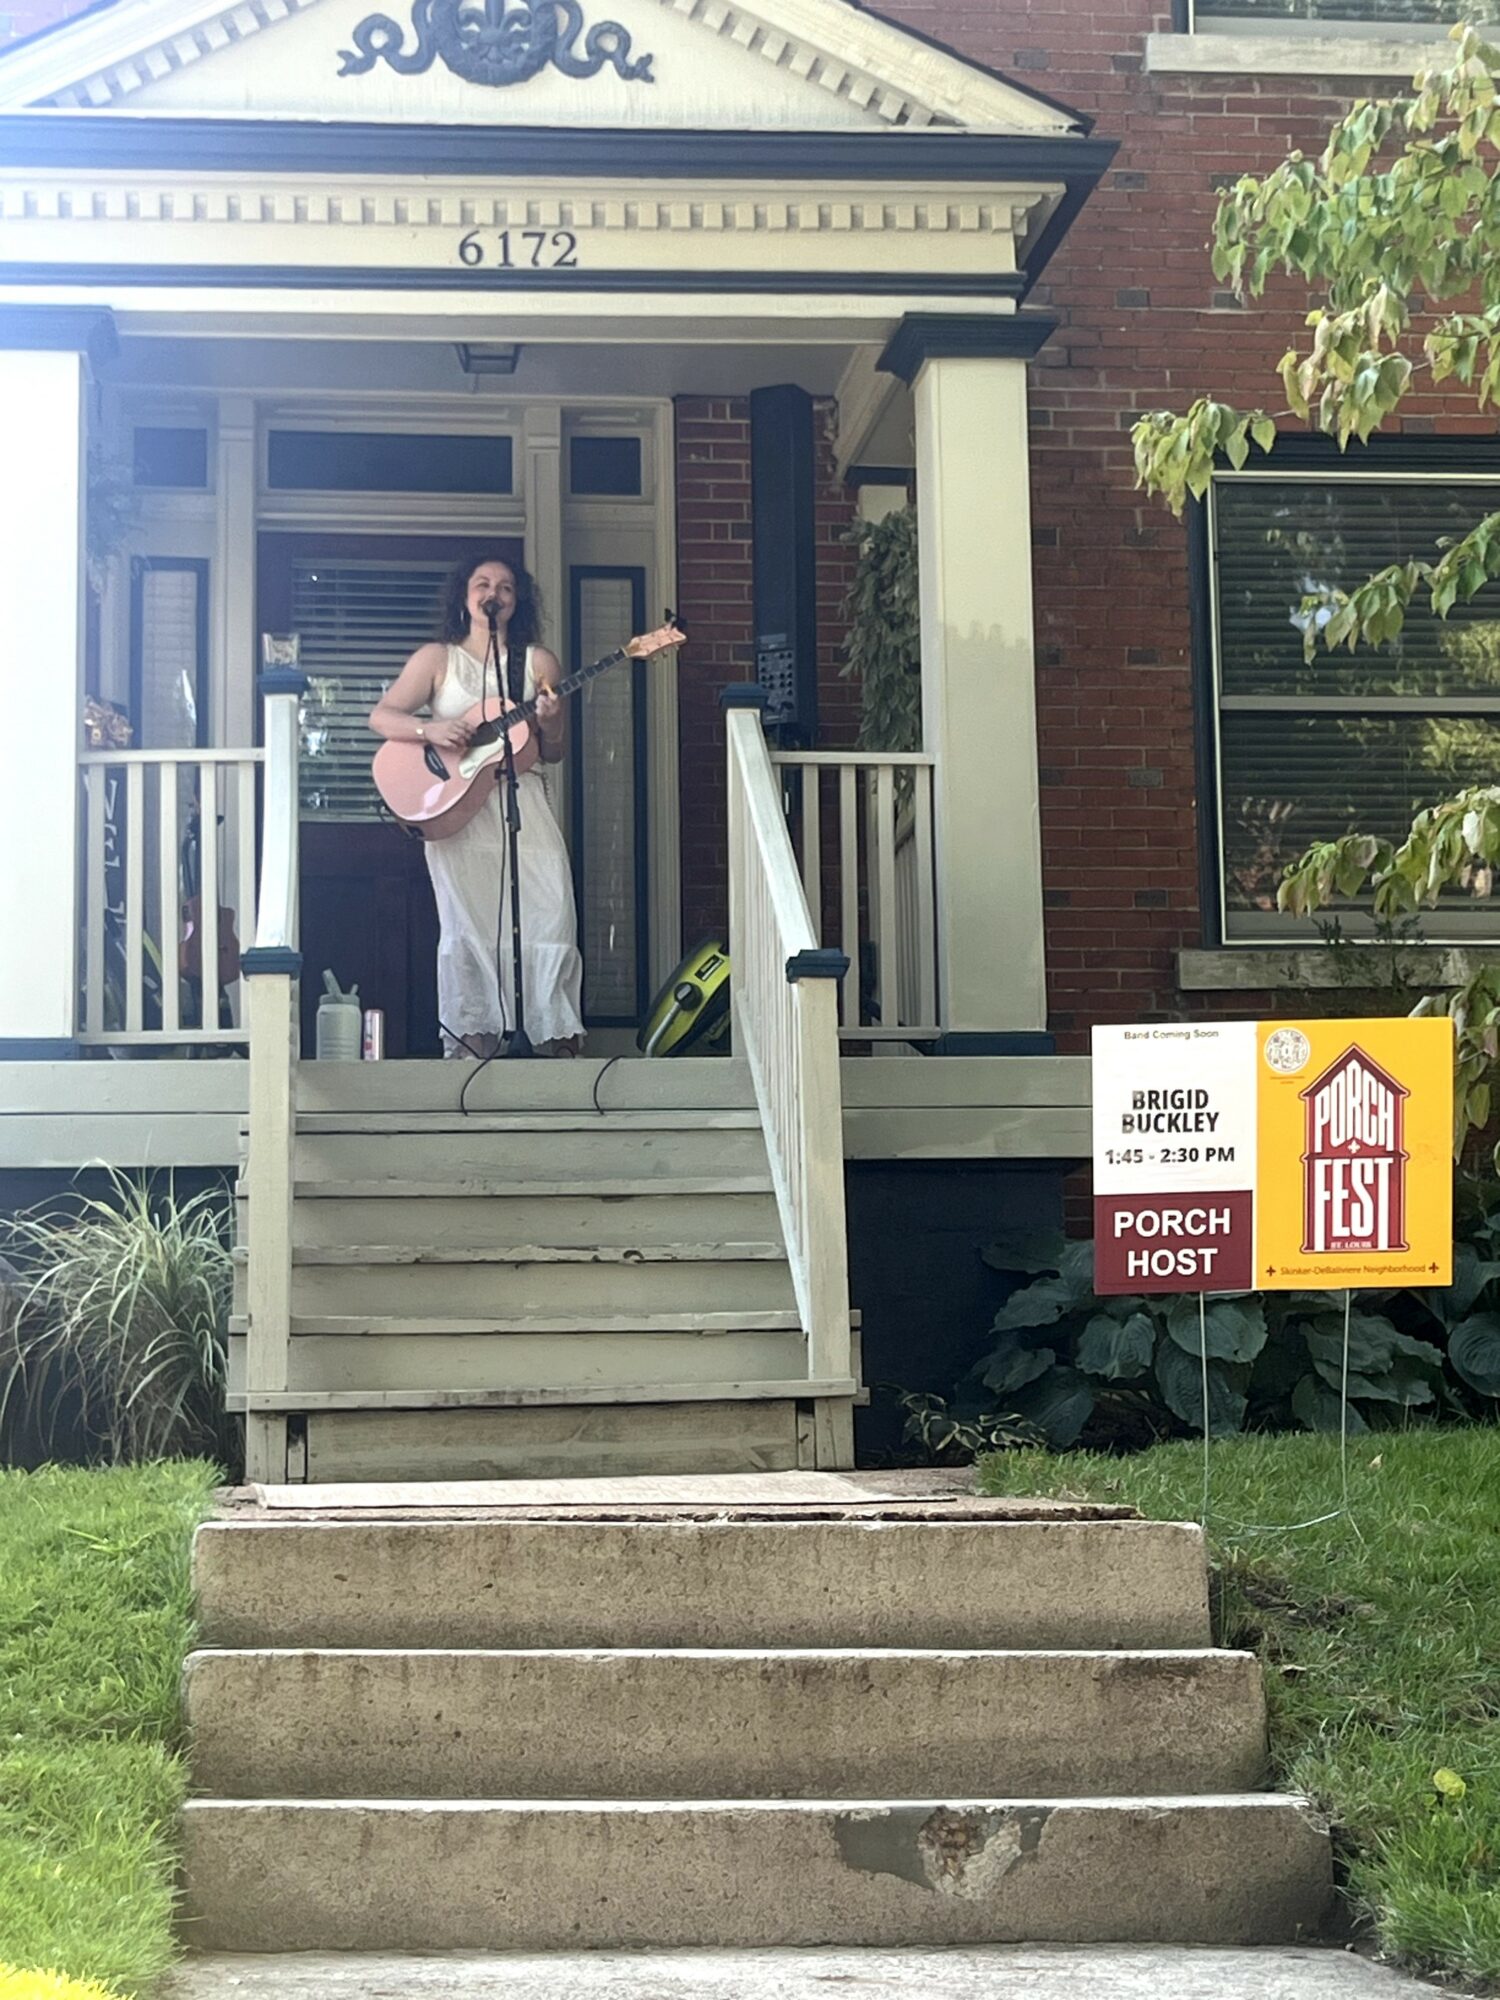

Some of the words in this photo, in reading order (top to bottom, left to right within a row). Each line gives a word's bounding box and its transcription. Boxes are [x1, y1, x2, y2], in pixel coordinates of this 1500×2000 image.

[458, 229, 578, 268] 6172
[1124, 1031, 1150, 1040] Band
[1152, 1029, 1191, 1040] Coming
[1193, 1029, 1219, 1038] Soon
[1132, 1088, 1209, 1110] BRIGID
[1314, 1058, 1395, 1153] PORCH
[1121, 1112, 1220, 1134] BUCKLEY
[1105, 1149, 1144, 1164] 1:45
[1160, 1148, 1200, 1163] 2:30
[1205, 1147, 1235, 1162] PM
[1314, 1157, 1394, 1252] FEST
[1114, 1208, 1231, 1238] PORCH
[1127, 1248, 1219, 1277] HOST
[1363, 1264, 1426, 1275] Neighborhood
